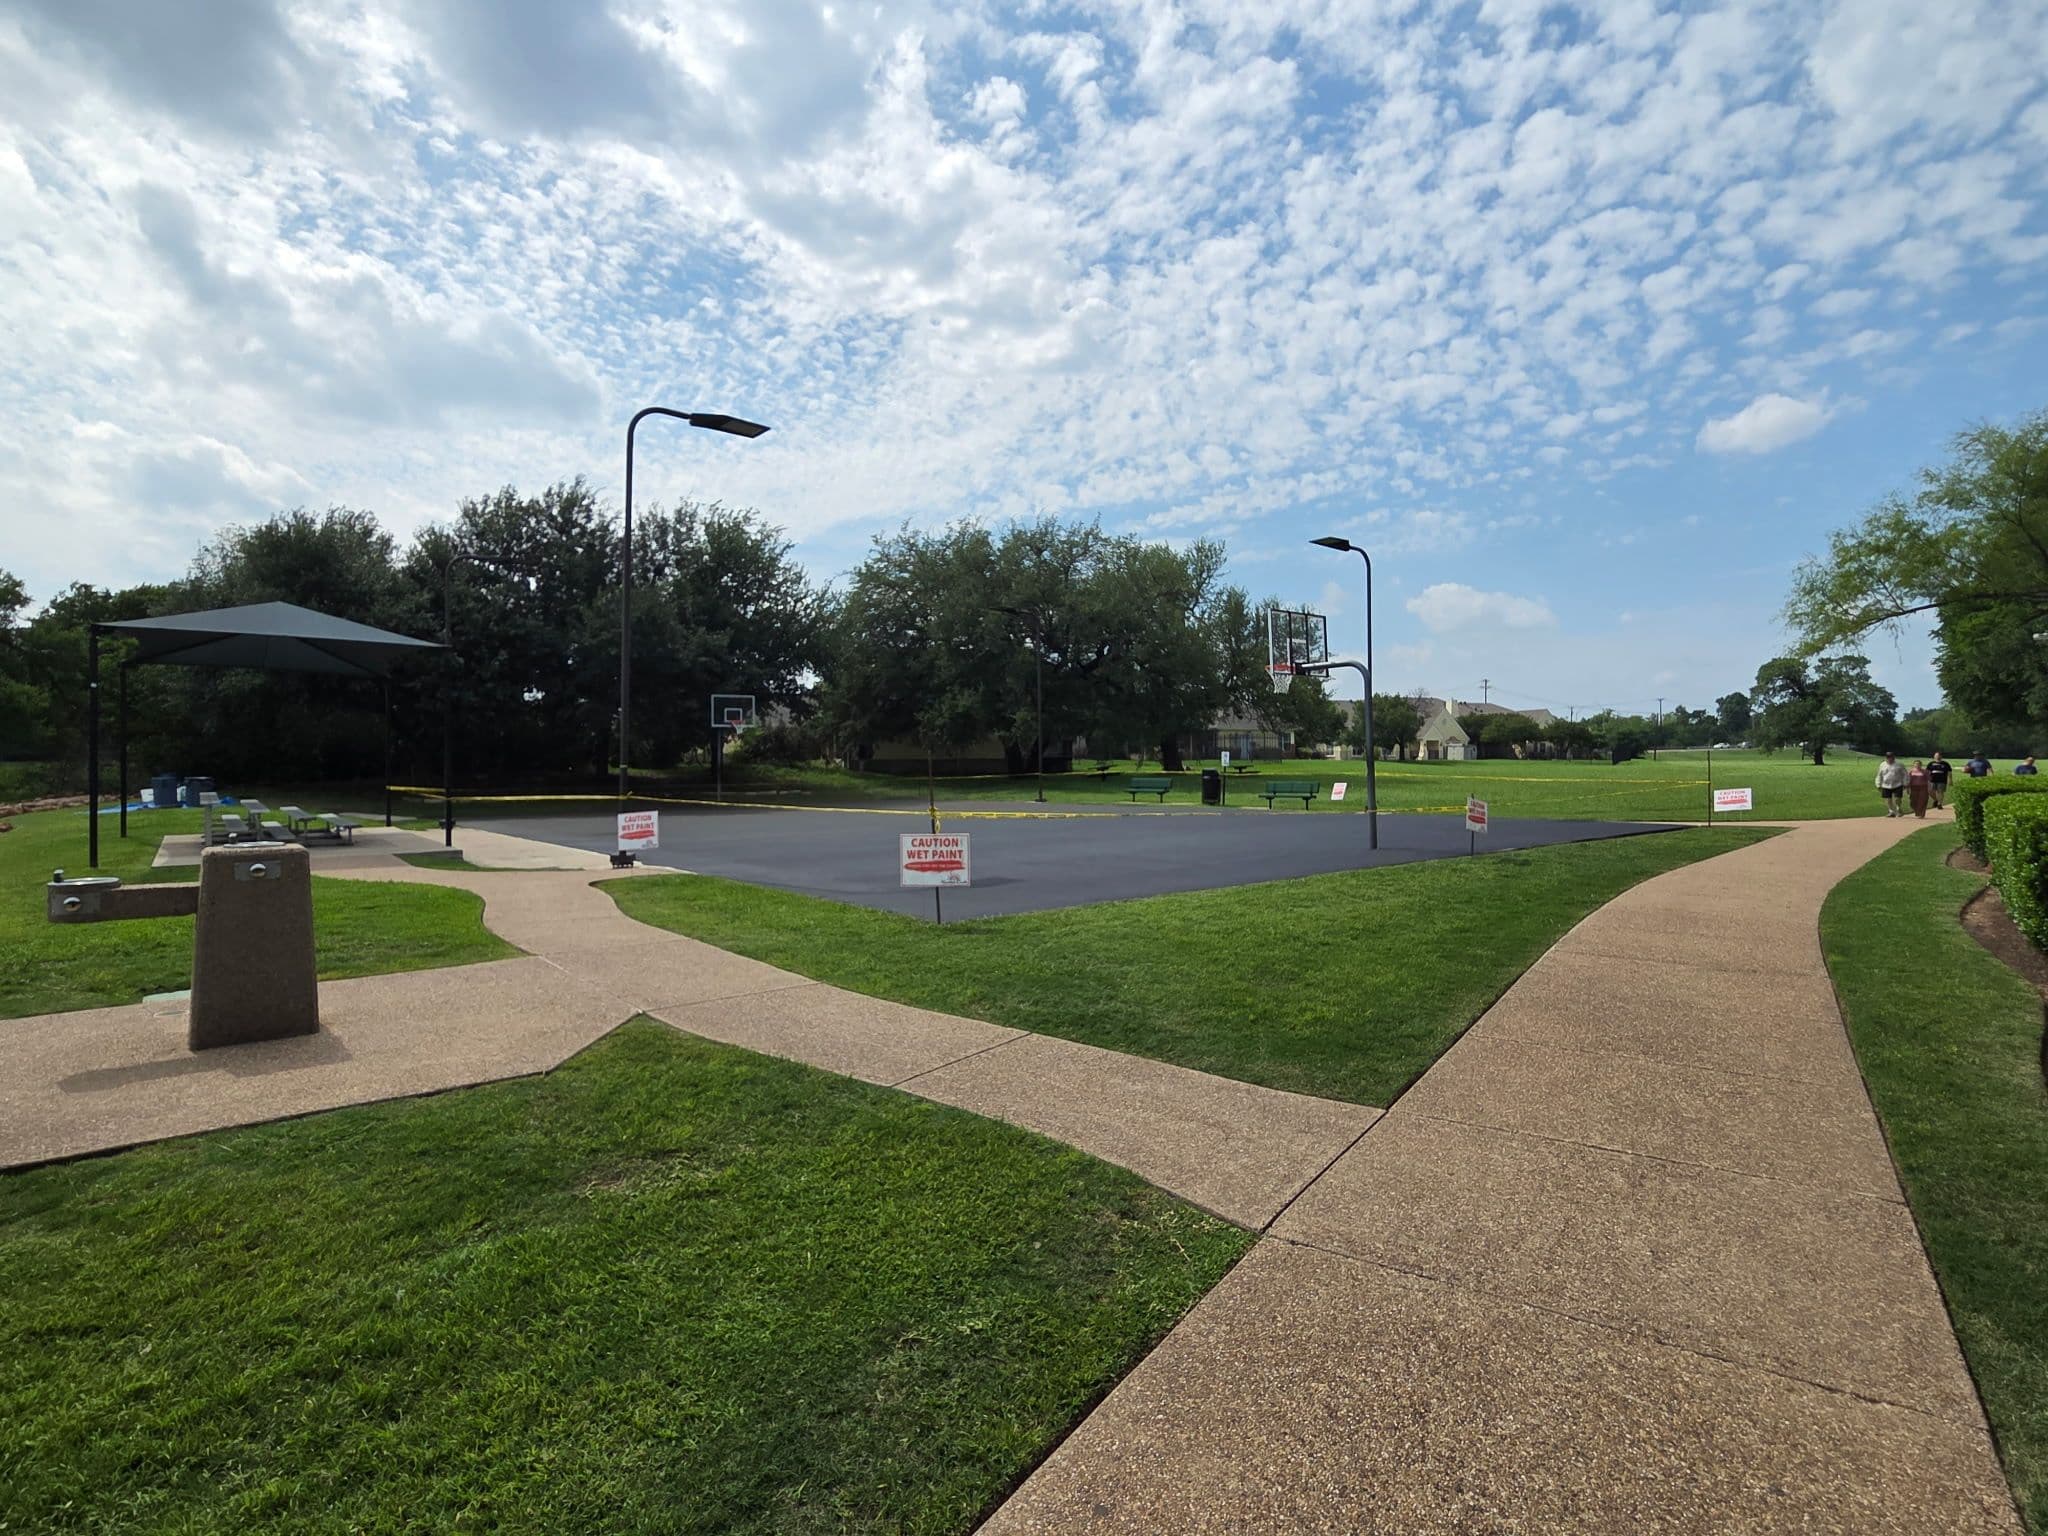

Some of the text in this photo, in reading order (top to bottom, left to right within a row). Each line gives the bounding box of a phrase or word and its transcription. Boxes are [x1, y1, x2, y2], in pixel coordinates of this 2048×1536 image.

[624, 815, 652, 823] CAUTION
[636, 822, 654, 830] PAINT
[911, 838, 959, 848] CAUTION
[907, 849, 964, 859] WET PAINT
